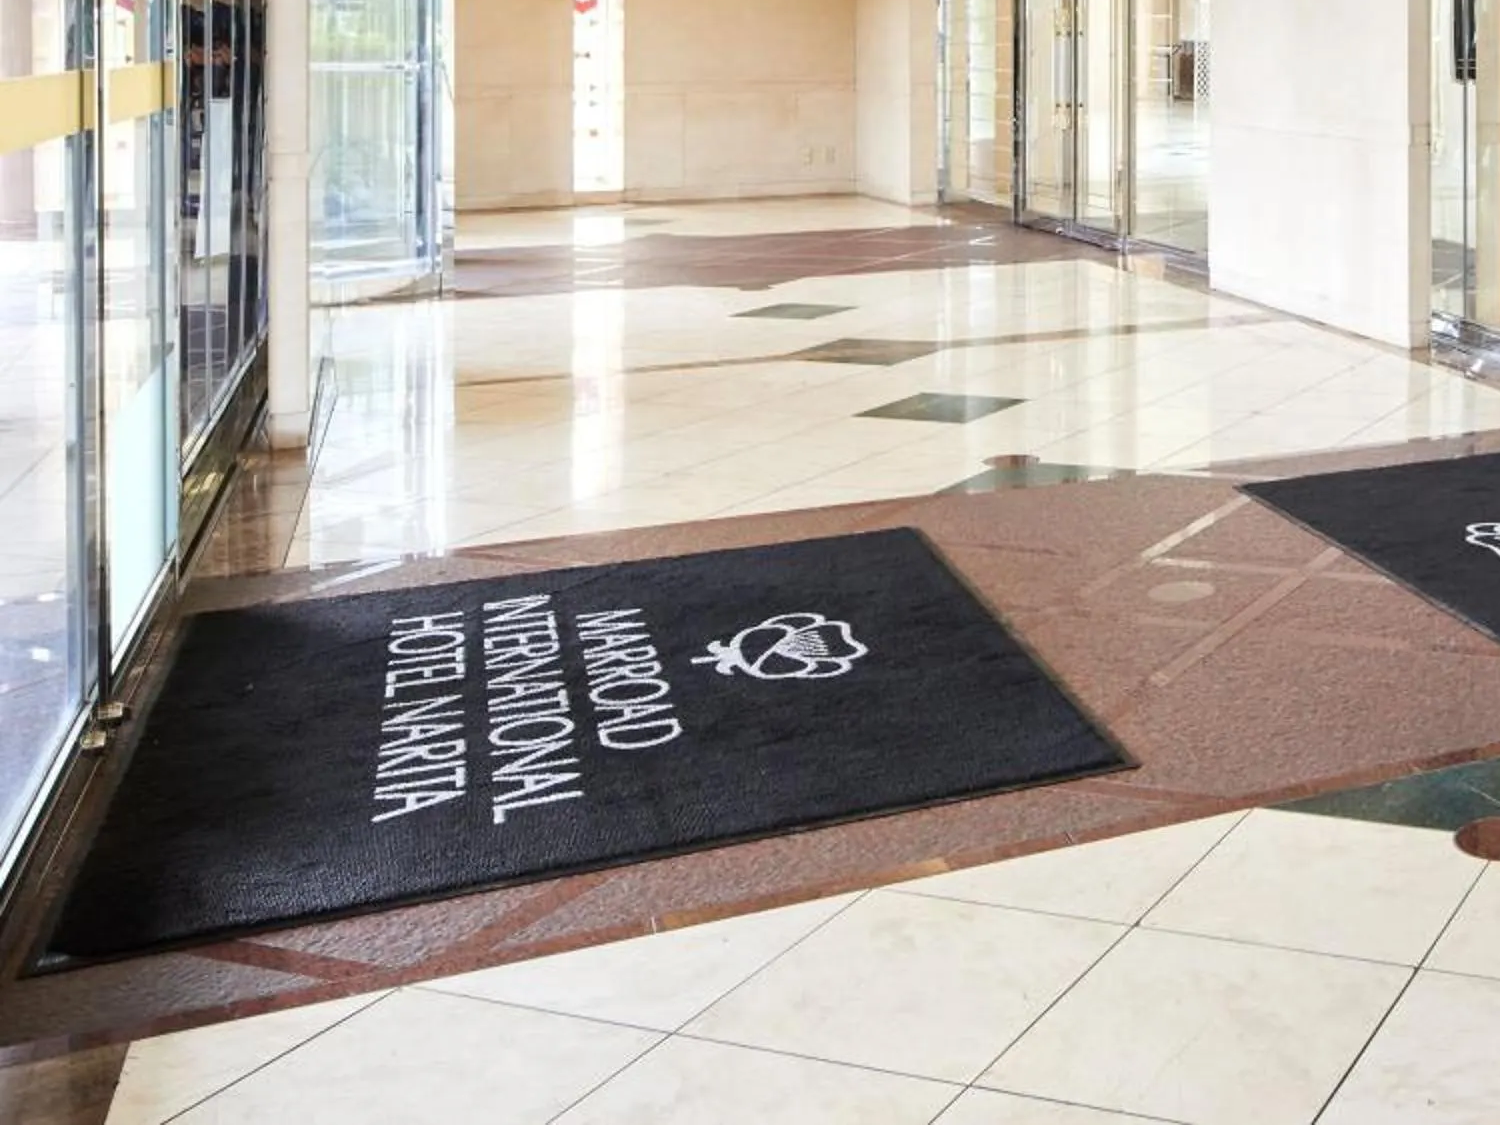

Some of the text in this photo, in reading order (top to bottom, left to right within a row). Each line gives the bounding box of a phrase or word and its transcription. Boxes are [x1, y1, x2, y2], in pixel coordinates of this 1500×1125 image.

[371, 610, 467, 823] HOTEL NARITA
[483, 594, 585, 825] INTERNATIONAL
[575, 608, 683, 750] MARROAD
